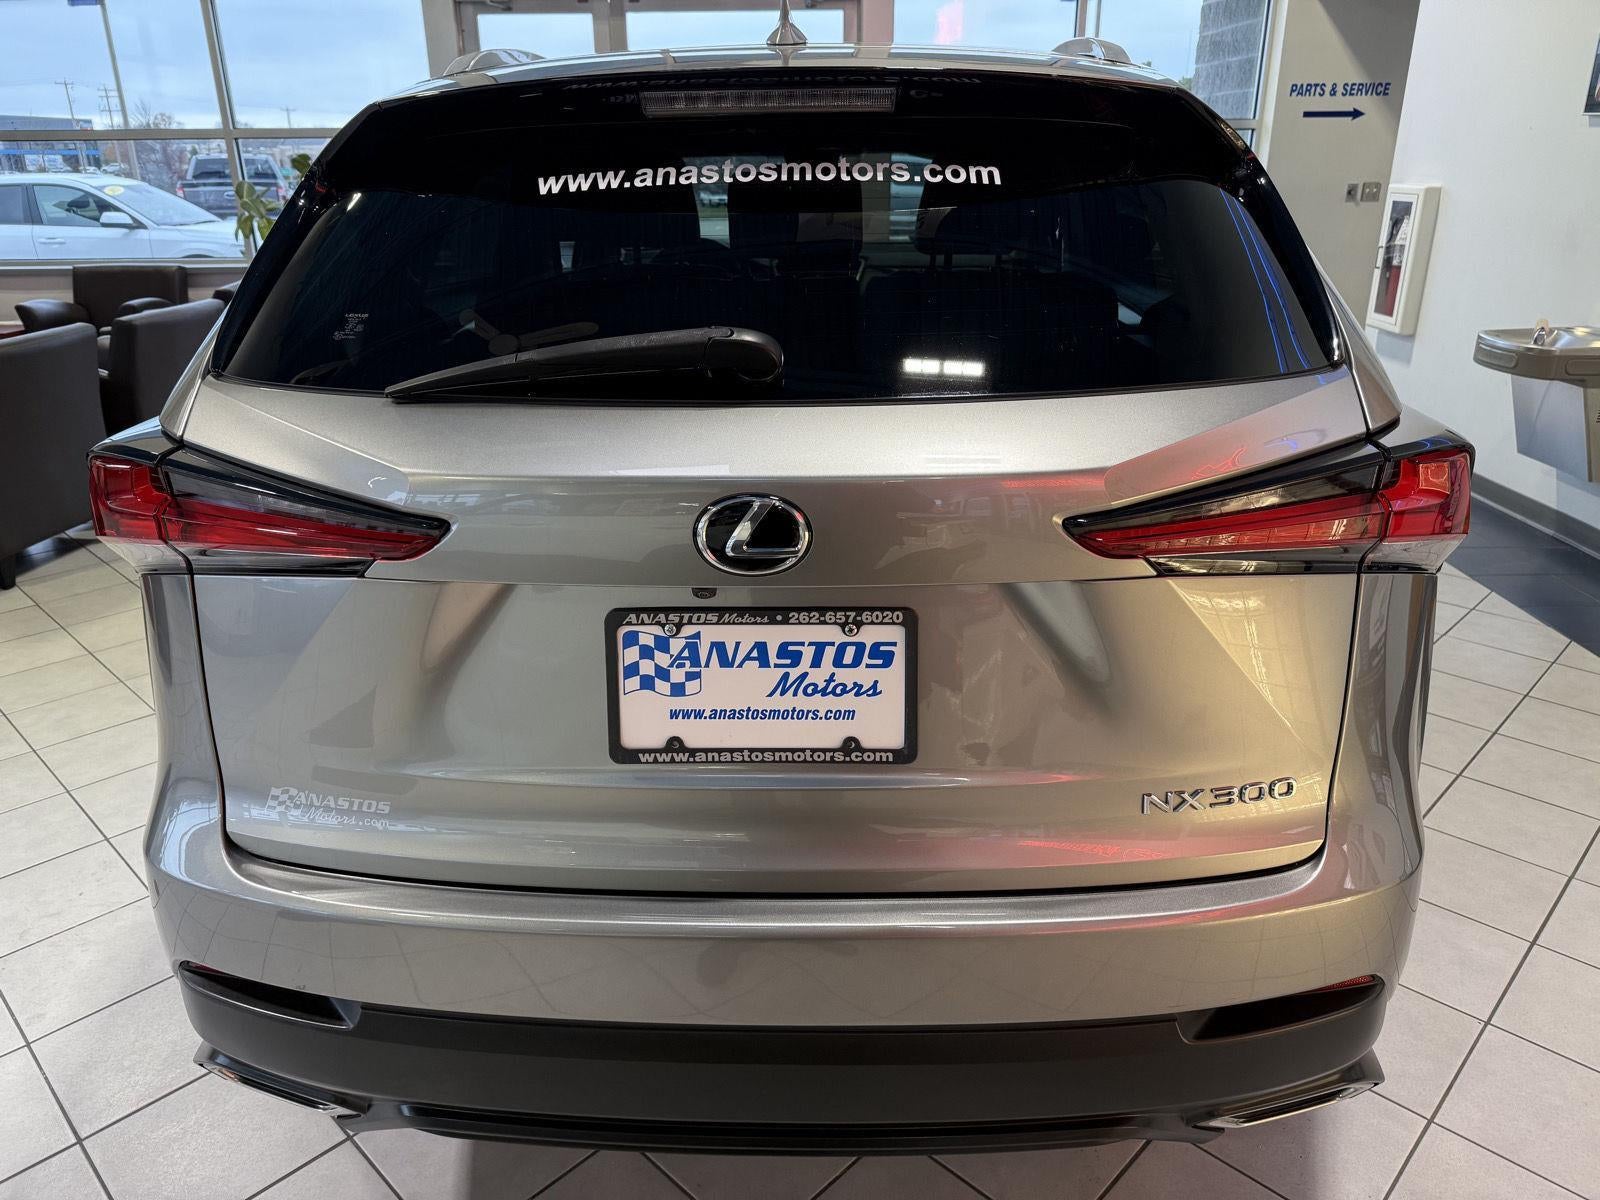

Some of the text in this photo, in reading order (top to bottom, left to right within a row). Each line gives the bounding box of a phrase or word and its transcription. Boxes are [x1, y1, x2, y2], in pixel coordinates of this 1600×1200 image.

[1289, 81, 1392, 98] PARTS & SERVICE
[536, 155, 1003, 197] www.anastosmotors.com
[622, 611, 904, 625] ANASTOS Motors 262-657-6020
[667, 638, 898, 669] ANASTOS
[765, 671, 883, 698] Motors
[669, 706, 856, 721] www.anastosmotors.com
[638, 749, 894, 764] www.anastosmotors.com
[294, 791, 391, 814] ANASTOS
